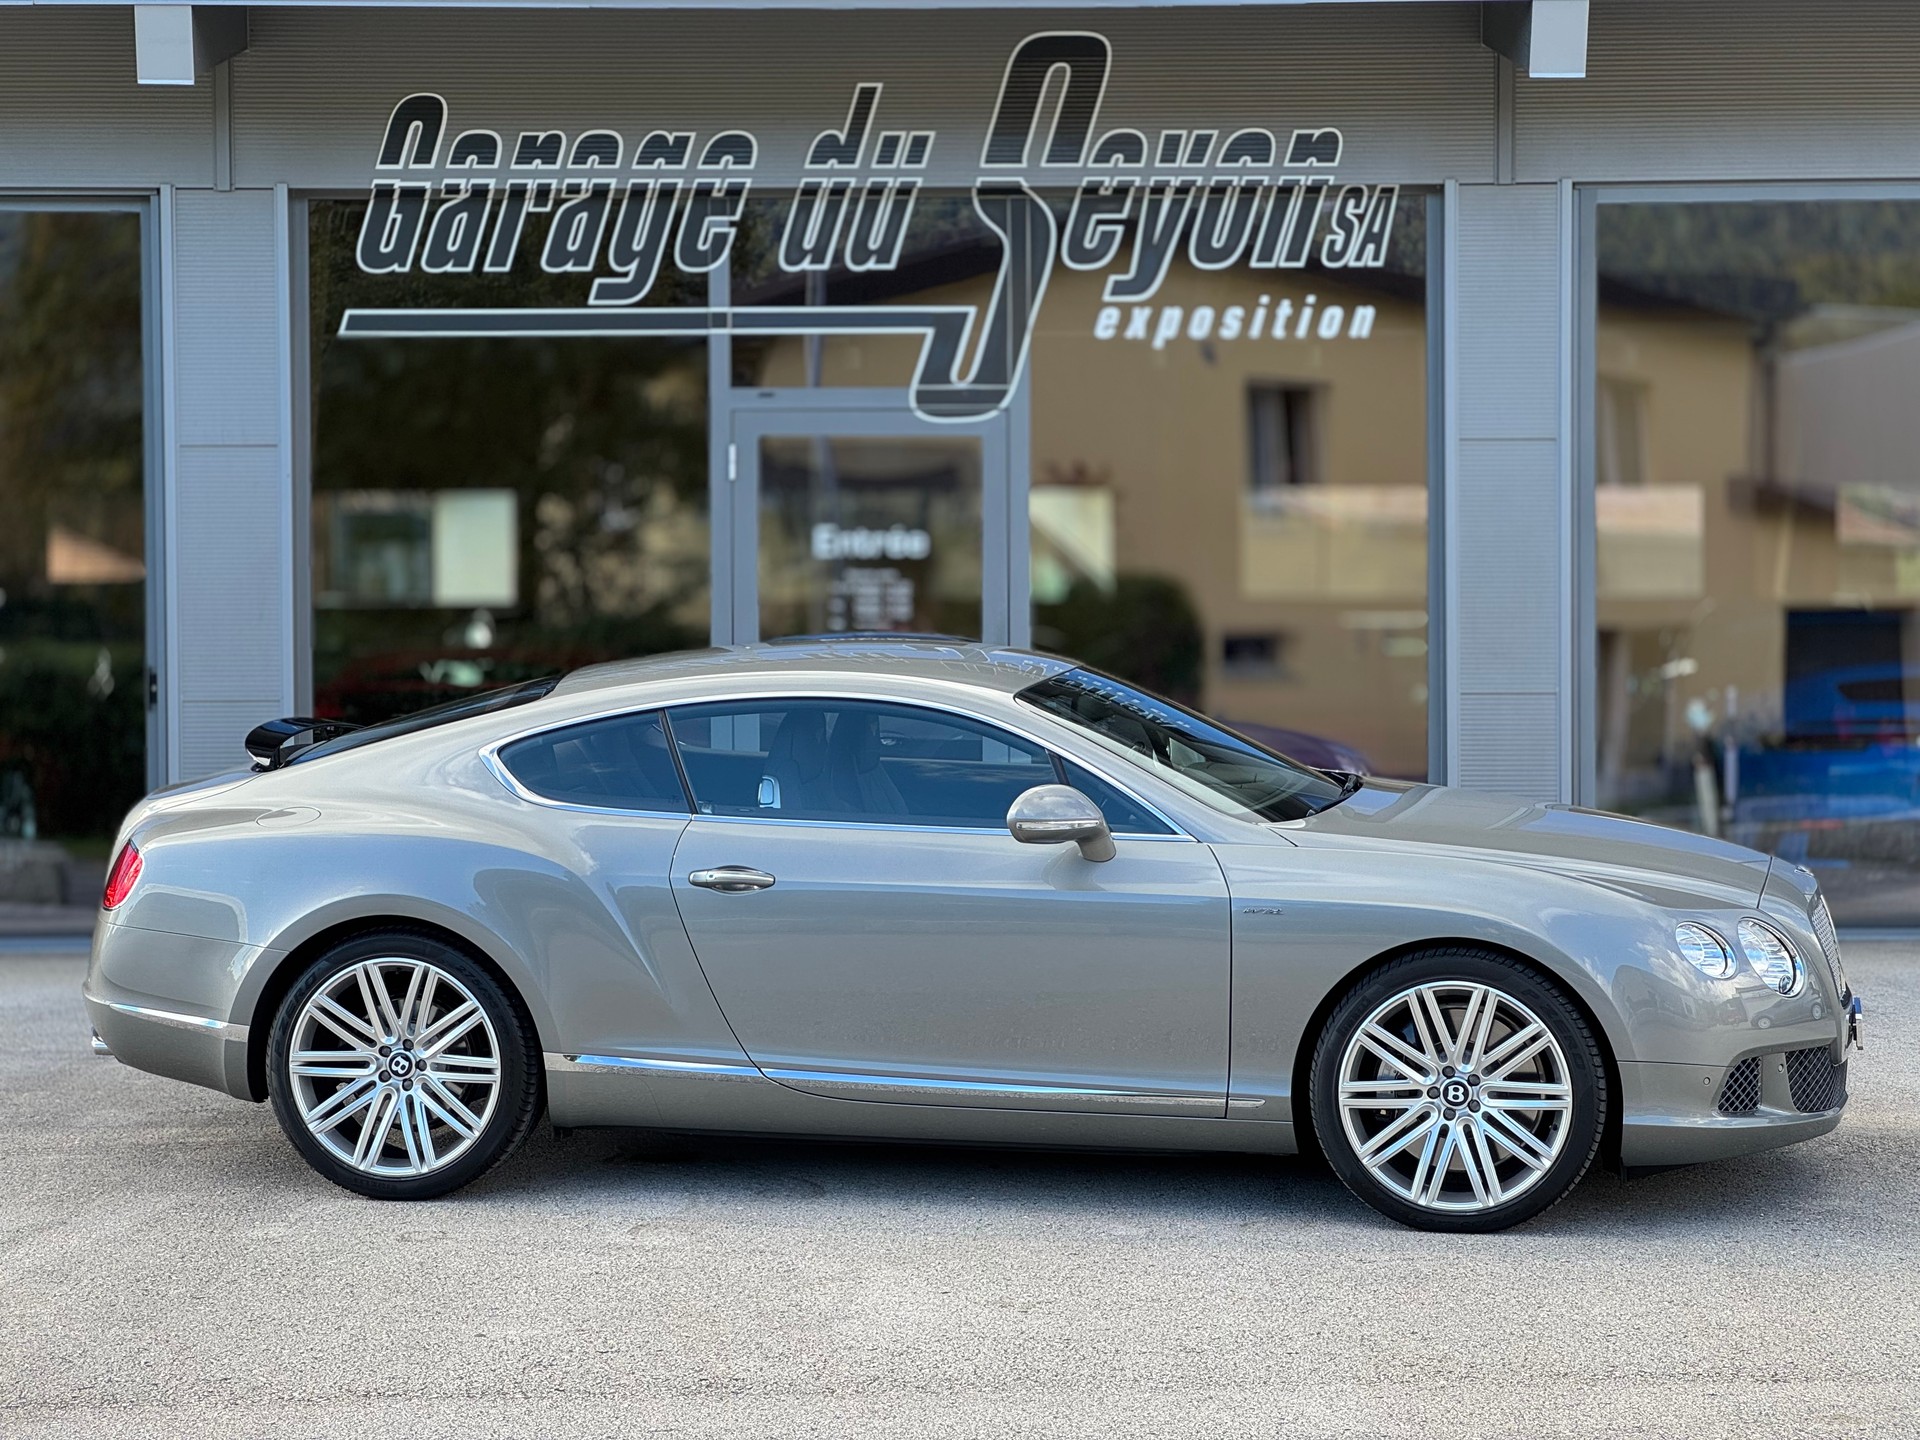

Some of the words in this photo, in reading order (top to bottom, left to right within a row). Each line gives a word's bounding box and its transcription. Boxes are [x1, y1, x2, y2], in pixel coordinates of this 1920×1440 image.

[356, 92, 758, 305] Garage
[778, 82, 935, 272] du
[1321, 184, 1400, 268] SA
[1093, 295, 1376, 350] exposition
[1447, 1084, 1465, 1103] B
